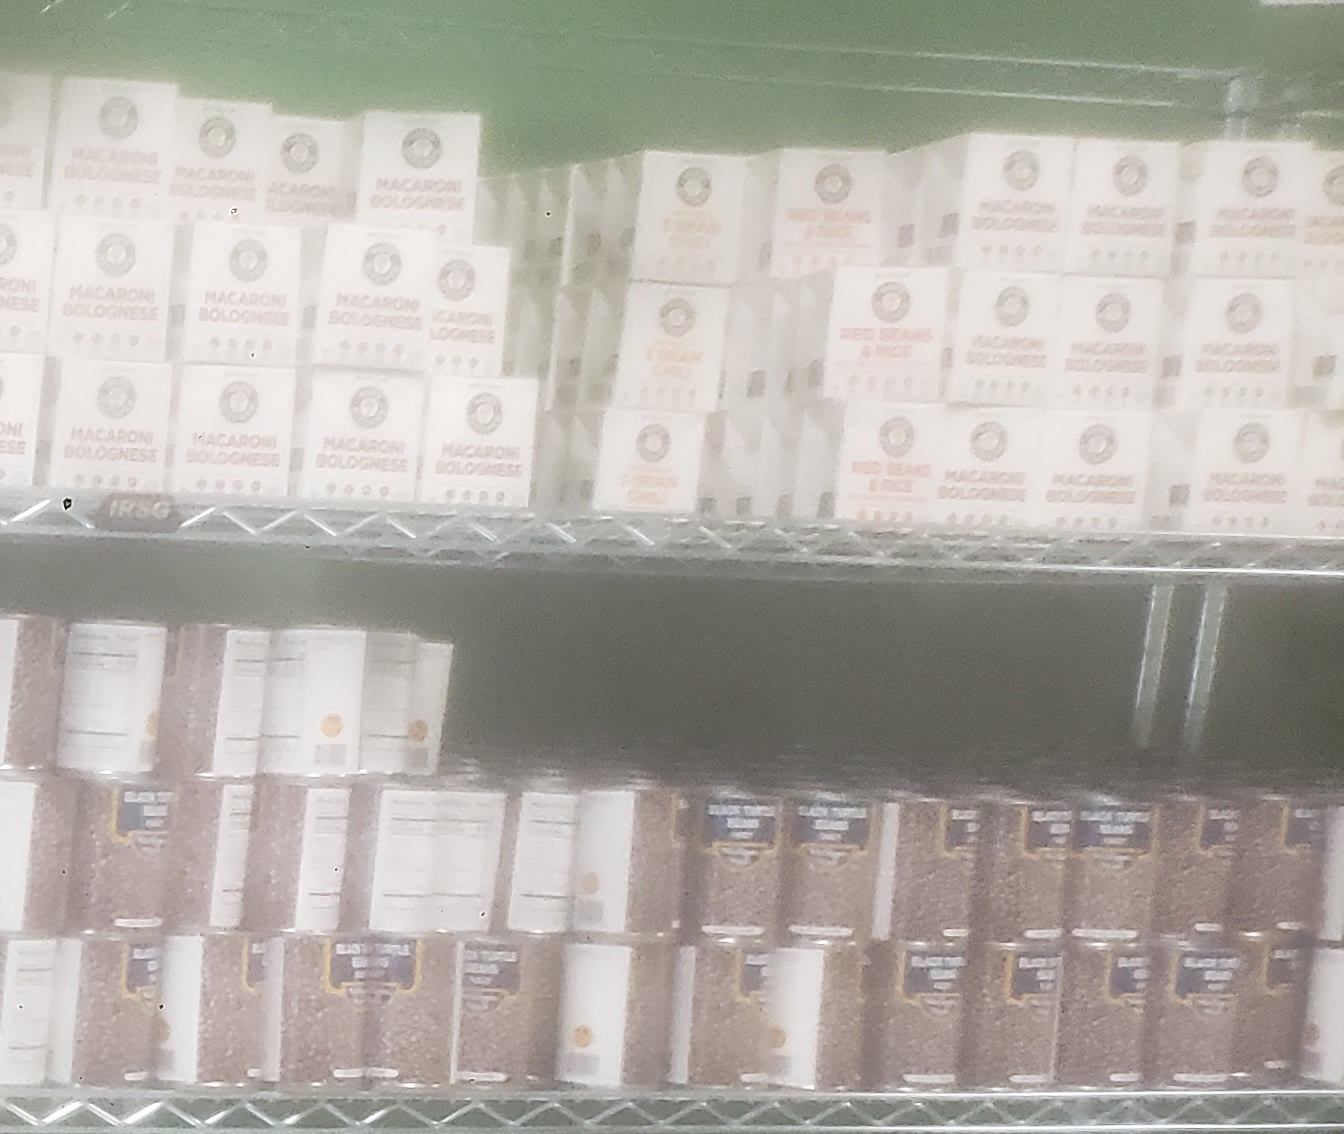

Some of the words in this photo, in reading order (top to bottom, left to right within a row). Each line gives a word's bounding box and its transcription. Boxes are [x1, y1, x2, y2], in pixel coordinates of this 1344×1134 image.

[375, 177, 463, 193] MACARONI
[369, 193, 466, 212] BOLOGNESE
[68, 284, 156, 304] MACARONI
[204, 289, 287, 308] MACARONI
[335, 292, 421, 312] MACARONI
[62, 302, 159, 323] BOLOGNESE
[198, 306, 290, 327] BOLOGNESE
[328, 309, 424, 331] BOLOGNESE
[431, 309, 494, 327] CARONI
[429, 324, 497, 345] LOGNESE
[70, 426, 154, 444] MACARONI
[191, 431, 278, 450] MACARONI
[322, 435, 406, 454] MACARONI
[63, 444, 158, 464] BOLOGNESE
[185, 449, 281, 468] BOLOGNESE
[441, 443, 521, 460] MACARONI
[315, 452, 409, 473] BOLOGNESE
[434, 459, 524, 479] BOLOGNESE
